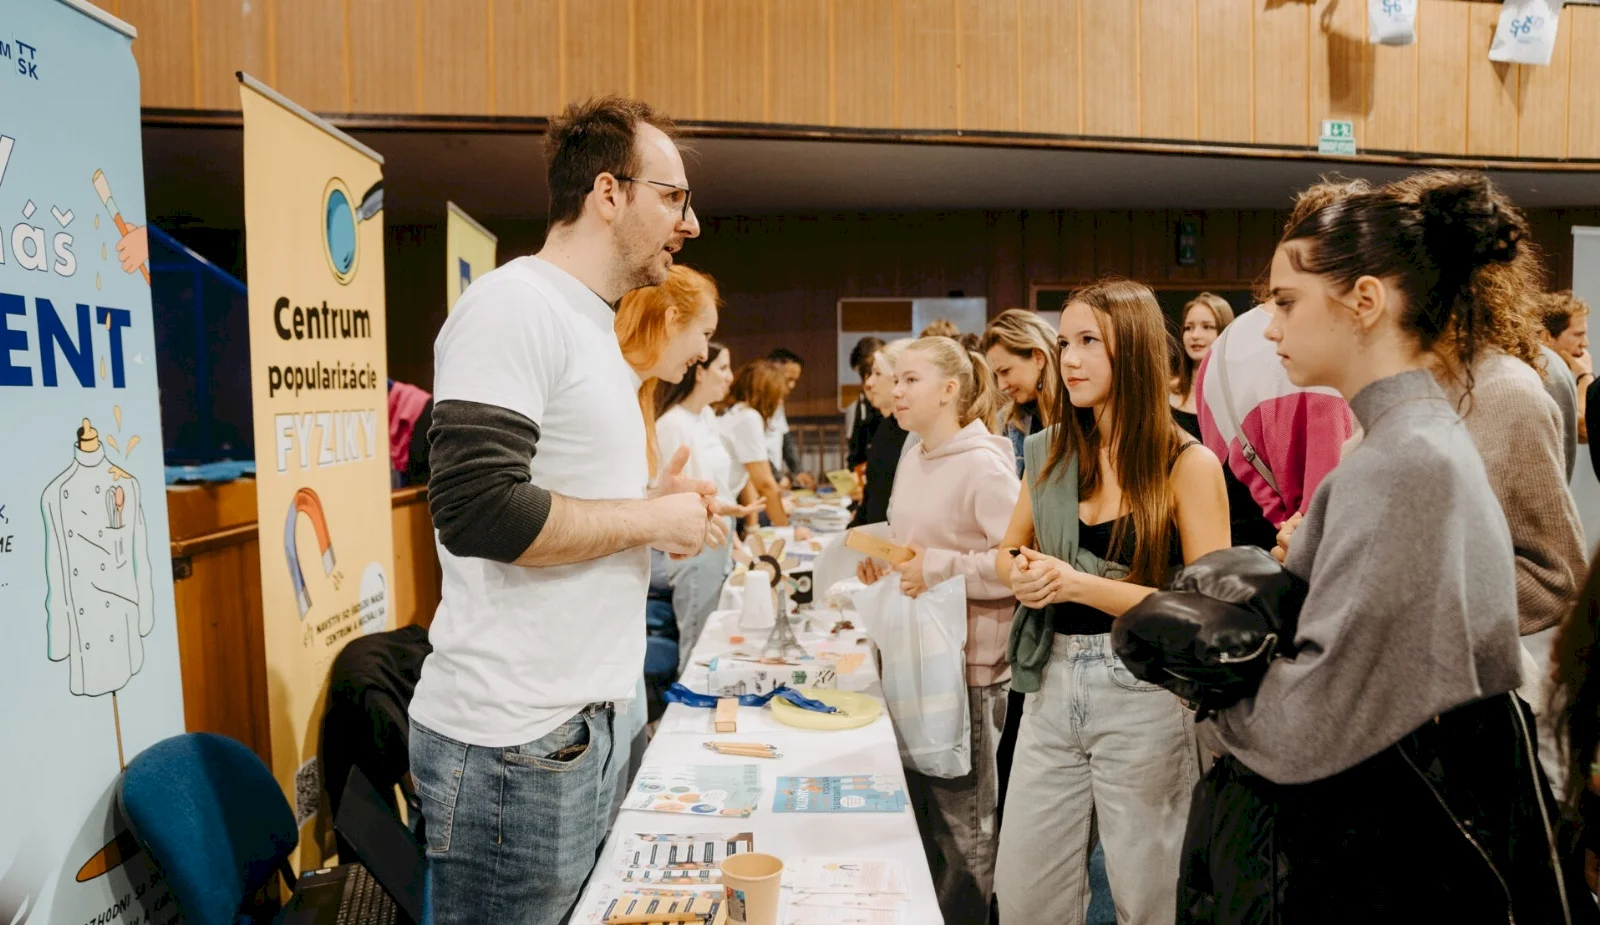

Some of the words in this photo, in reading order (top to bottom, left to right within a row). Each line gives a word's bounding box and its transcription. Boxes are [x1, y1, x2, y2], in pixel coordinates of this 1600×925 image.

[18, 57, 39, 80] SK
[273, 296, 372, 341] Centrum
[268, 360, 377, 398] popularizácie
[274, 408, 377, 473] FYZIKY
